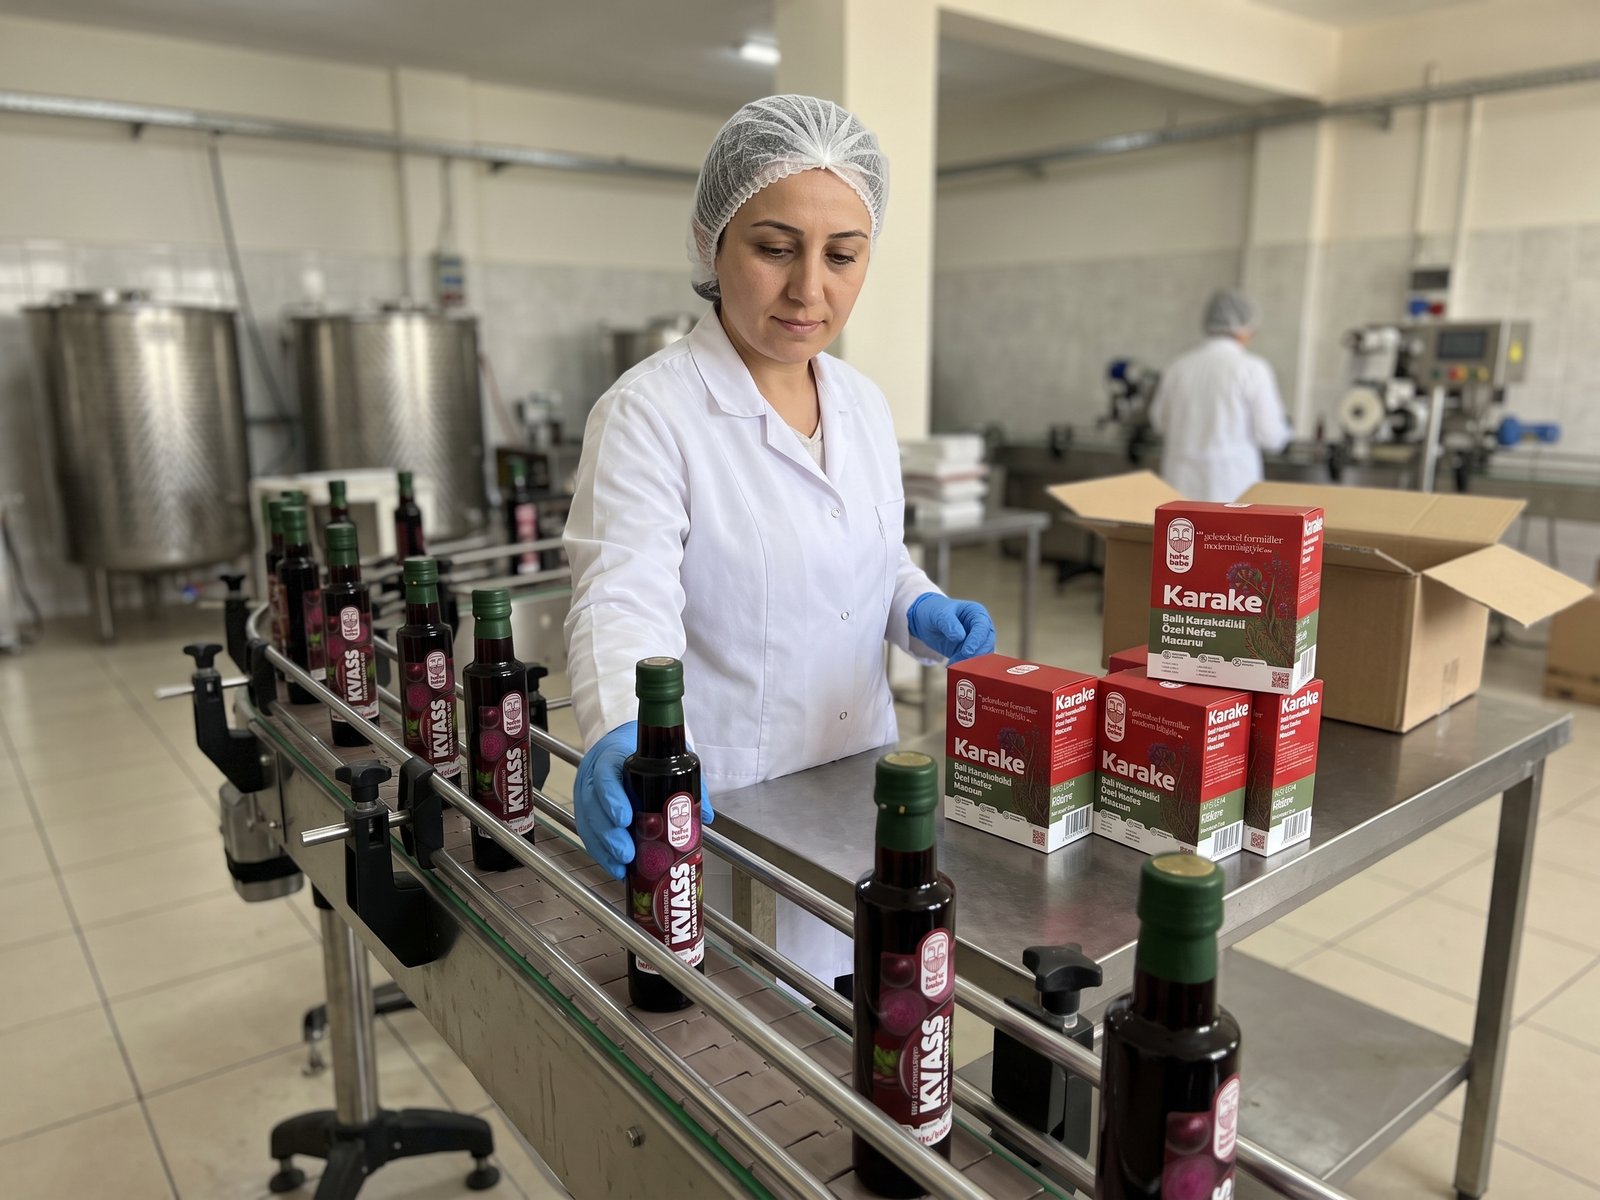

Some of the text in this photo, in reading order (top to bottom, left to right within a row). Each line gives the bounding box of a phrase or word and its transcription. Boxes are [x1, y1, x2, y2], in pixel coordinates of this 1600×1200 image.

[1163, 584, 1263, 613] Karake
[1161, 622, 1217, 638] Özel Nefes
[345, 649, 363, 702] KVASS
[1055, 687, 1096, 711] Karake
[1207, 702, 1249, 727] Karake
[1281, 690, 1319, 714] Karake
[430, 699, 449, 758] KVASS
[954, 737, 1025, 775] Karake
[1102, 750, 1176, 792] Karake
[506, 747, 524, 813] KVASS
[670, 862, 691, 945] KVASS
[919, 1014, 945, 1114] KVASS
